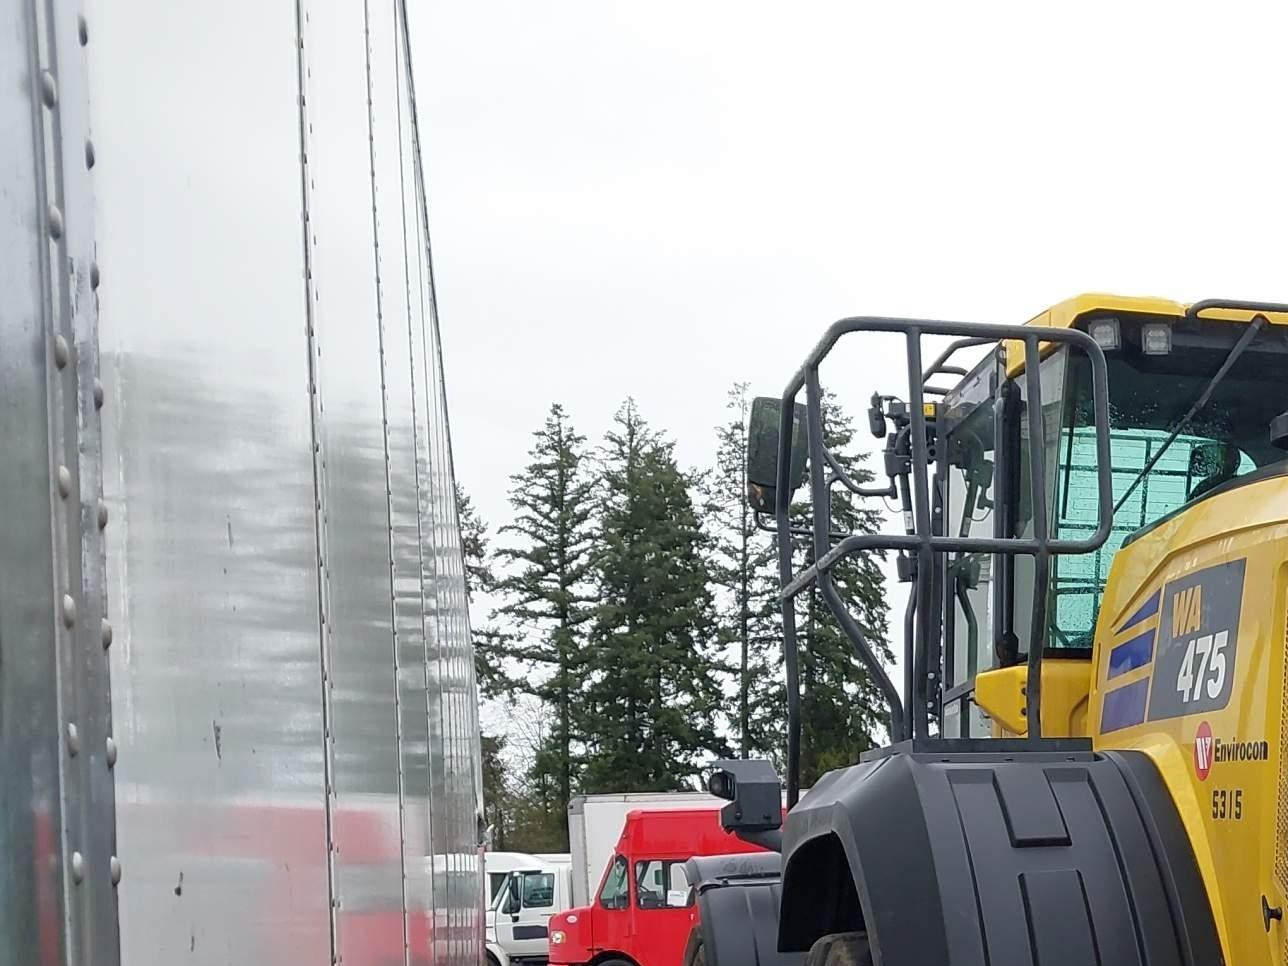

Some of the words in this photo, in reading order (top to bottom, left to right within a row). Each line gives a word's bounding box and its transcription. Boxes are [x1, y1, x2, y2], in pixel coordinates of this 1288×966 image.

[1172, 584, 1201, 638] WA
[1176, 630, 1229, 703] 475
[1214, 737, 1269, 762] Envirocon
[1212, 790, 1242, 820] 5315
